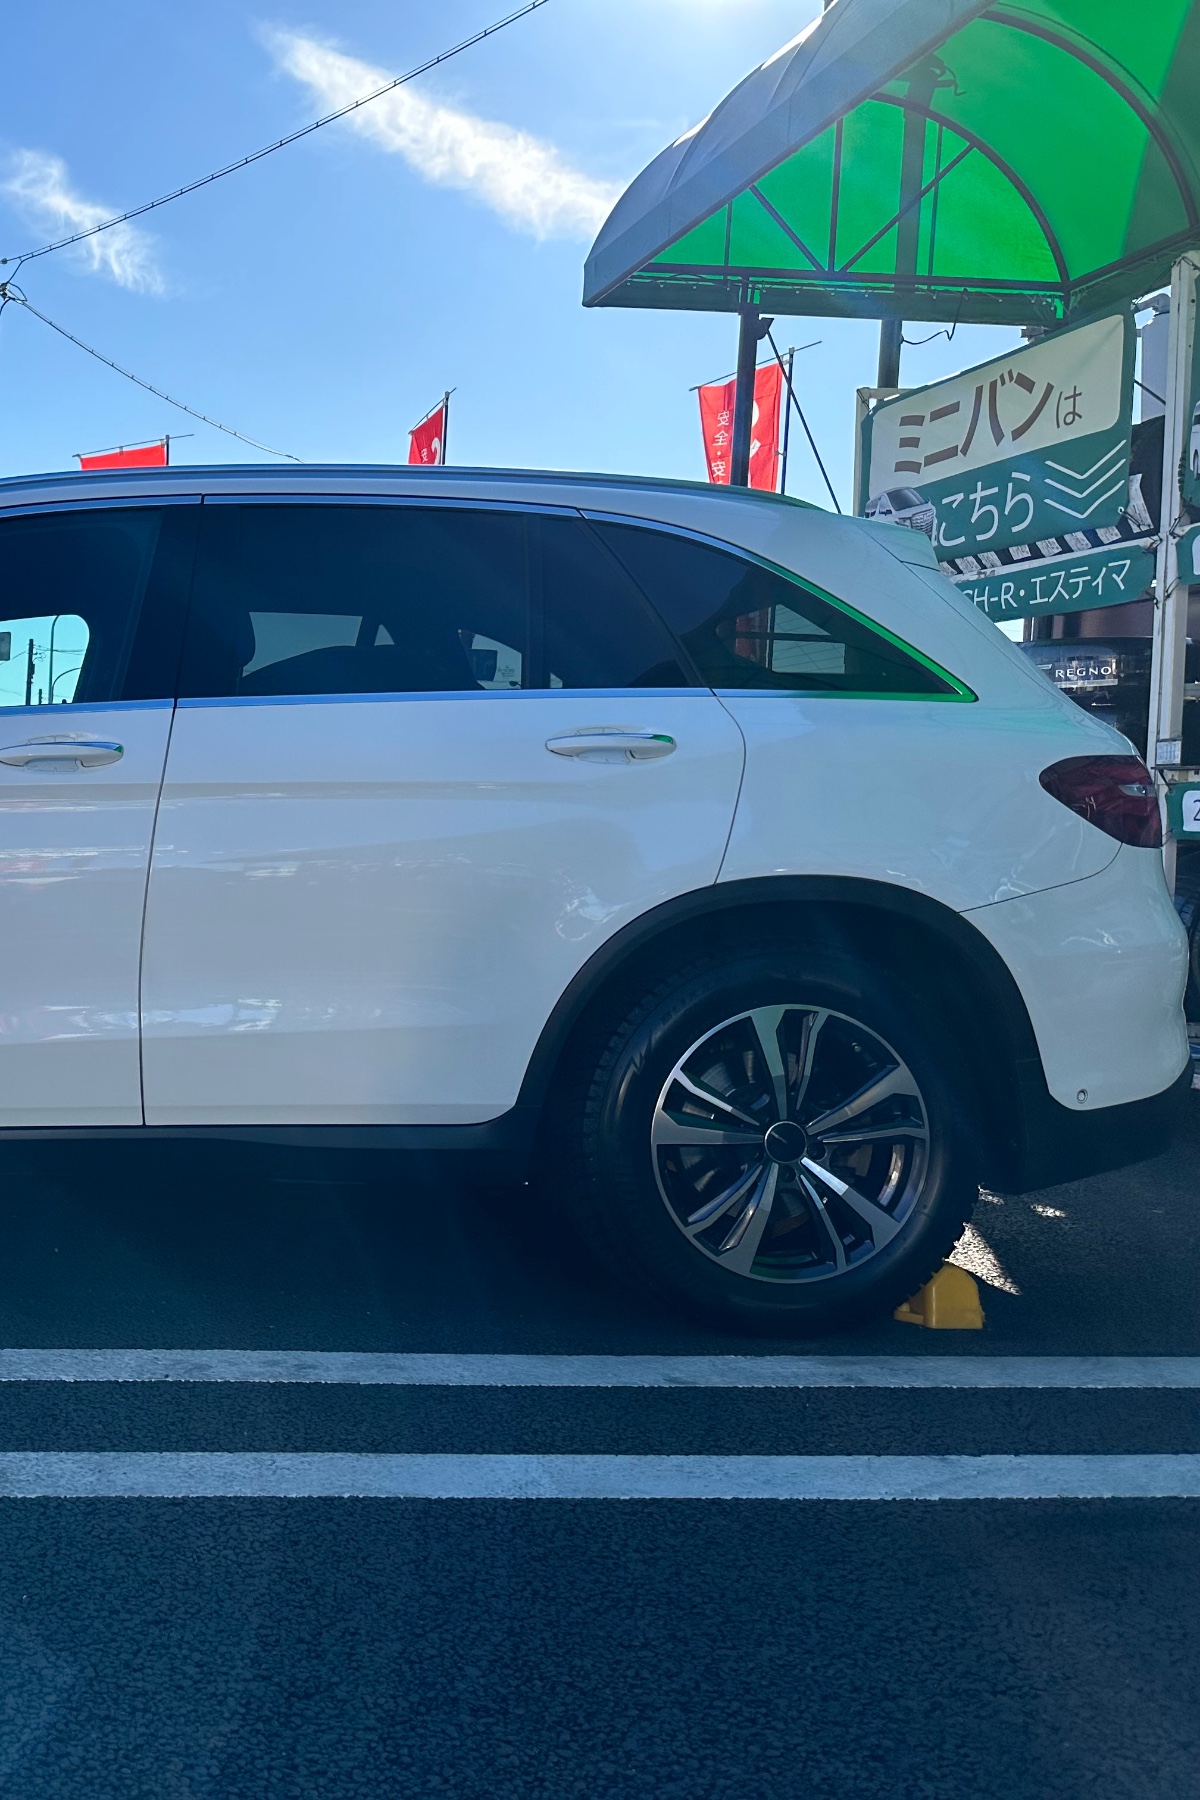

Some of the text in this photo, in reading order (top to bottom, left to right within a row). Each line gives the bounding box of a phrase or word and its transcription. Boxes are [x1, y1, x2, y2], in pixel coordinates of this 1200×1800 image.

[894, 369, 1082, 474] ミニバンは
[937, 471, 1035, 547] こちら
[1055, 666, 1111, 679] REGNO
